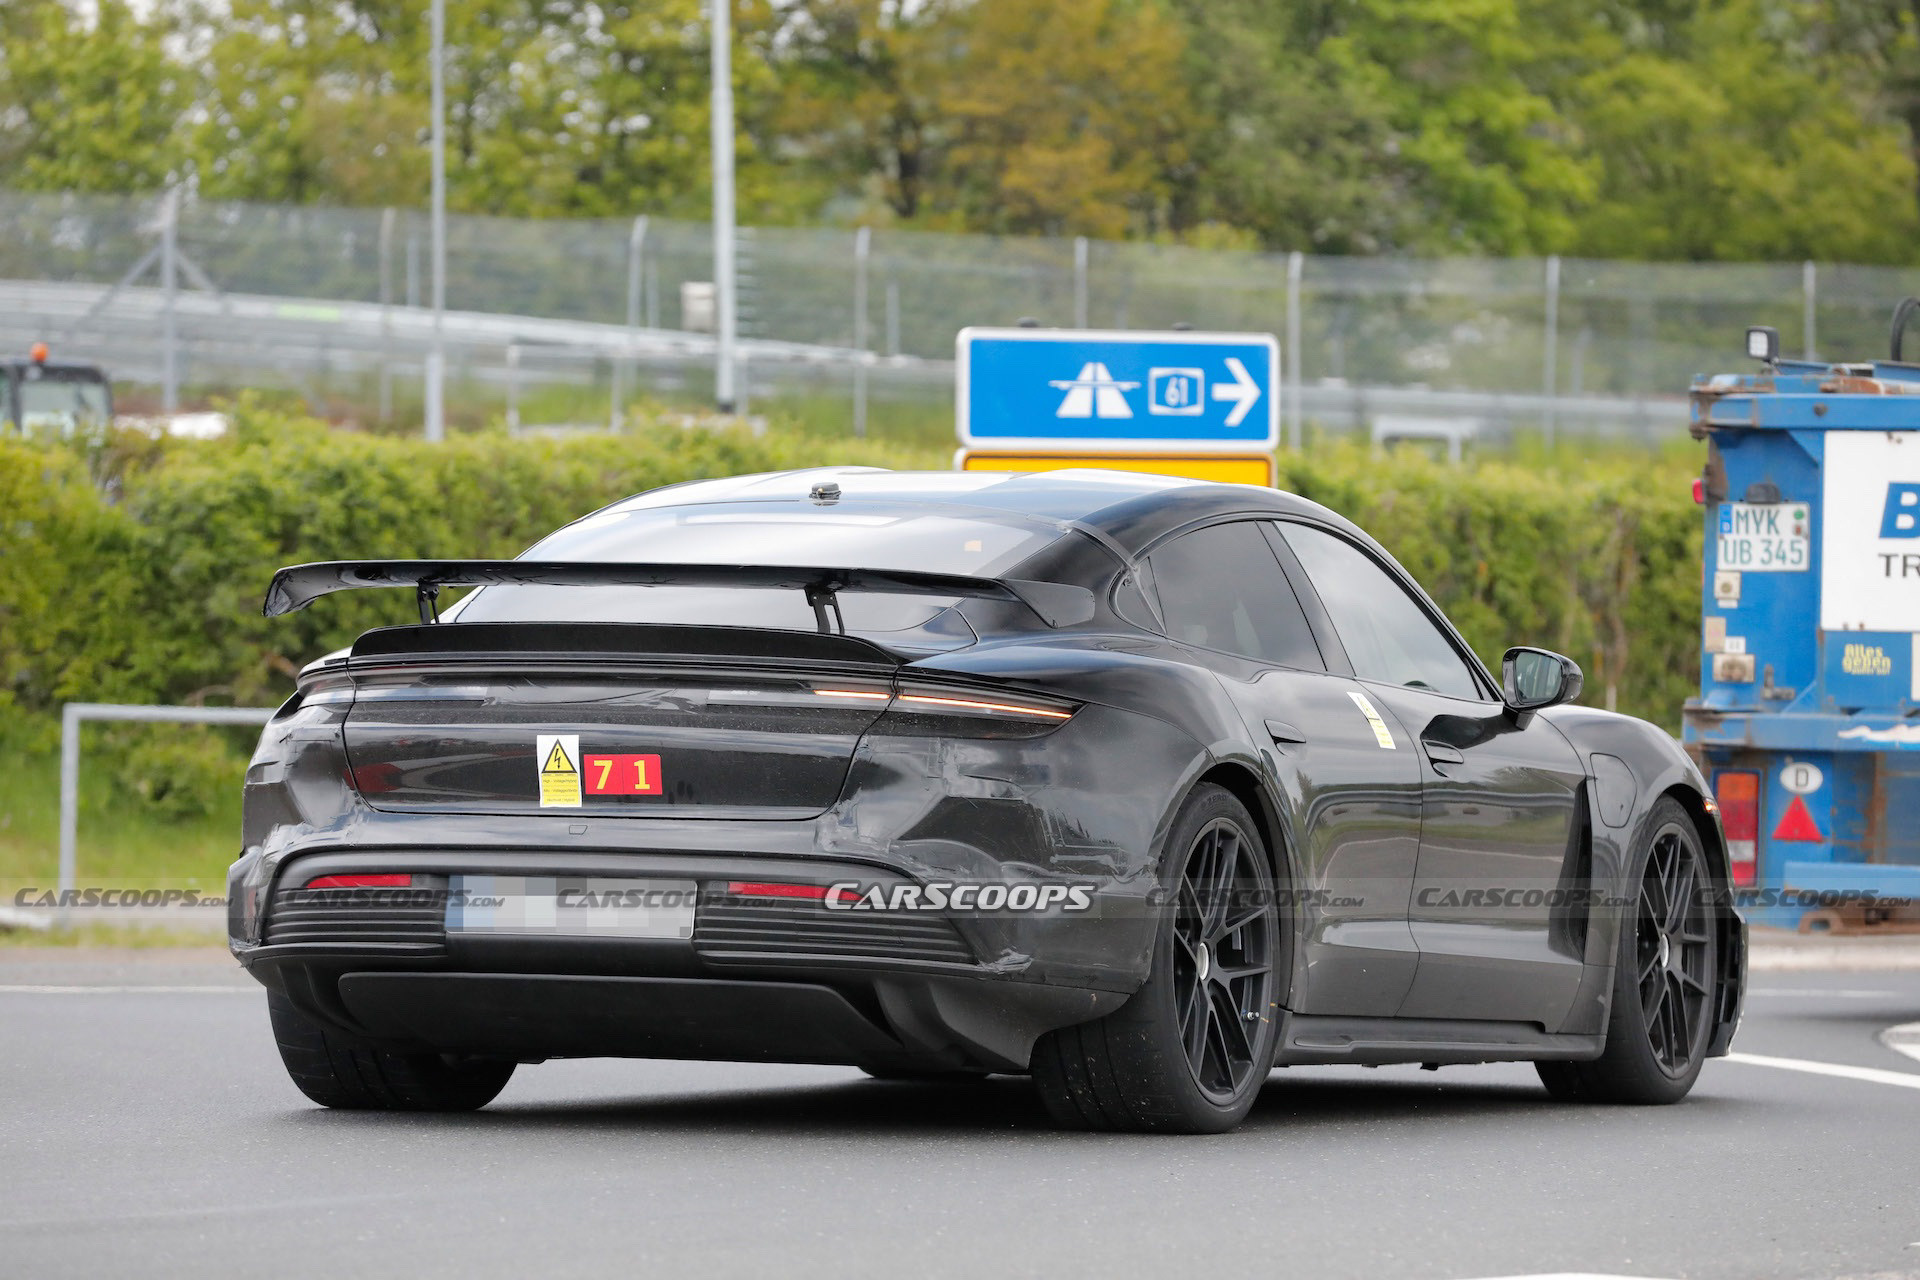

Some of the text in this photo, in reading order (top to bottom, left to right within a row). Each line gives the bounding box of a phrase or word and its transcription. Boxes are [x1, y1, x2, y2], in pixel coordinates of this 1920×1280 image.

[1165, 376, 1189, 406] 61
[1736, 509, 1780, 535] MYK
[1723, 538, 1804, 565] UB 345
[1795, 768, 1809, 788] D
